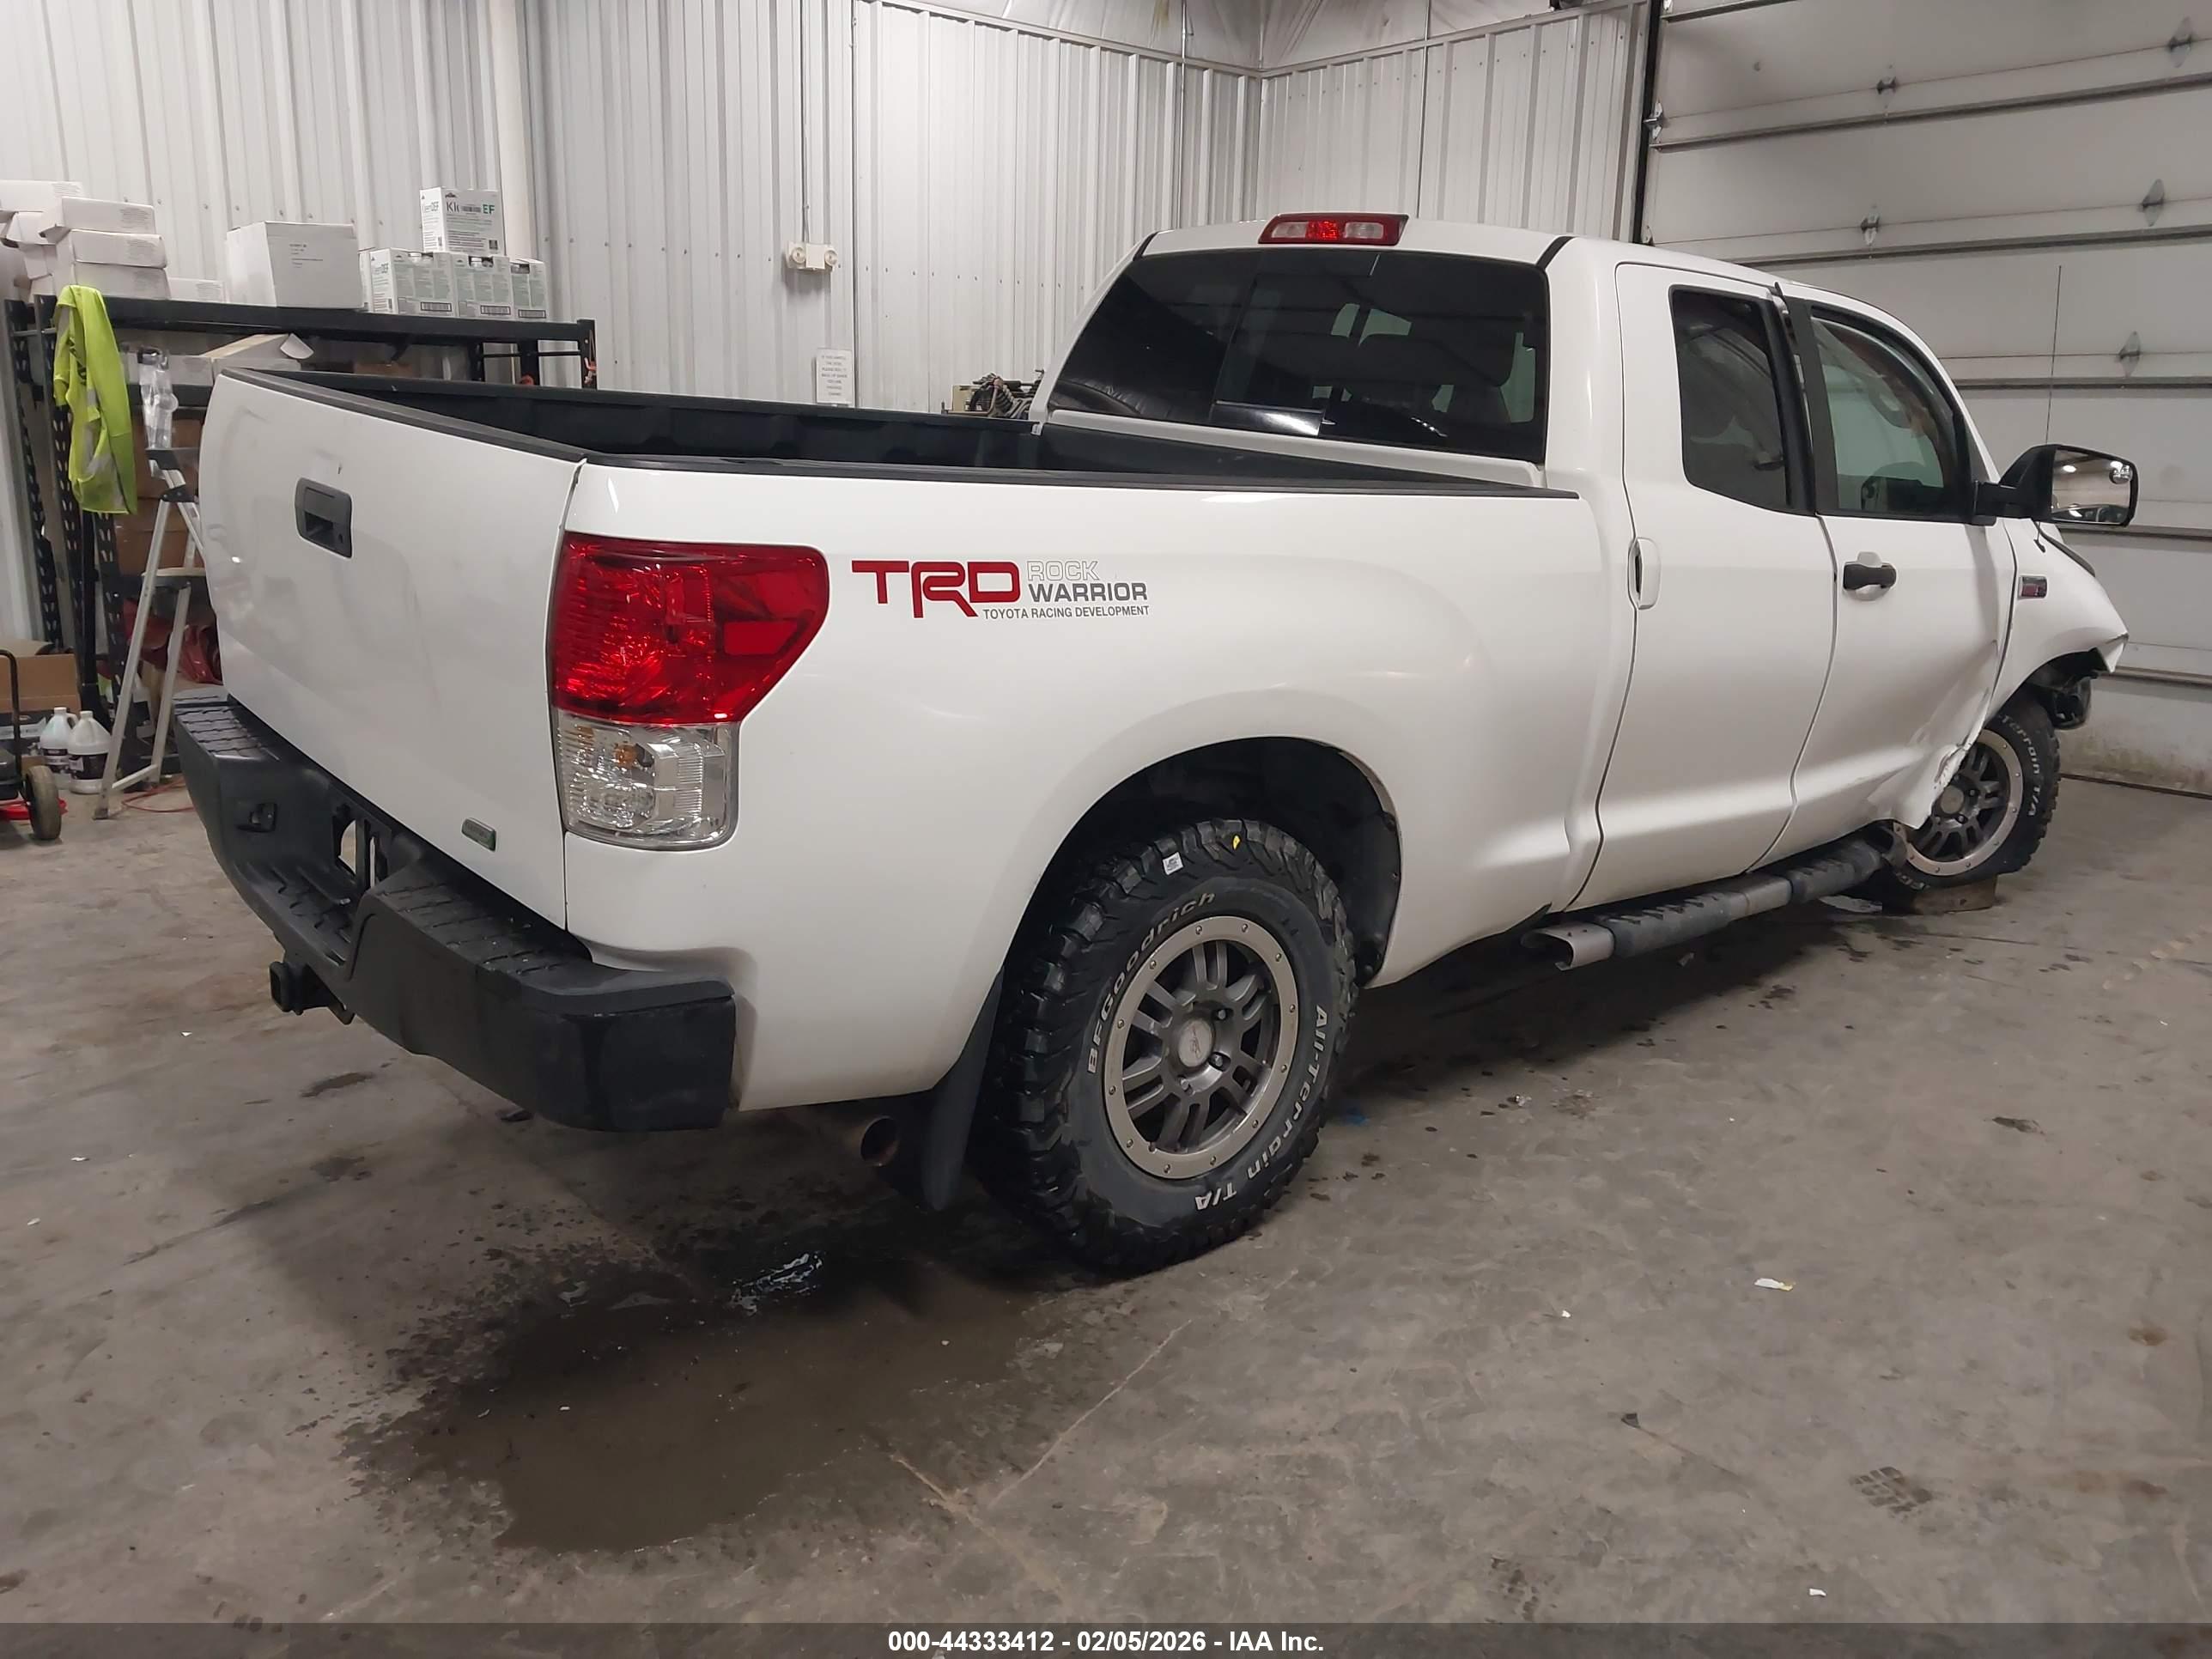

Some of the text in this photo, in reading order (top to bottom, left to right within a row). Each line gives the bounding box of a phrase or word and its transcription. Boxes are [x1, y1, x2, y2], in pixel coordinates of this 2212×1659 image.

[851, 560, 1020, 618] TRD
[1027, 561, 1099, 580] ROCK
[1029, 582, 1147, 602] WARRIOR
[983, 605, 1150, 619] TOYOTA RACING DEVELOPMENT
[1087, 892, 1216, 1073] BFGoodrich
[1194, 1005, 1328, 1210] All-Terrain T/A
